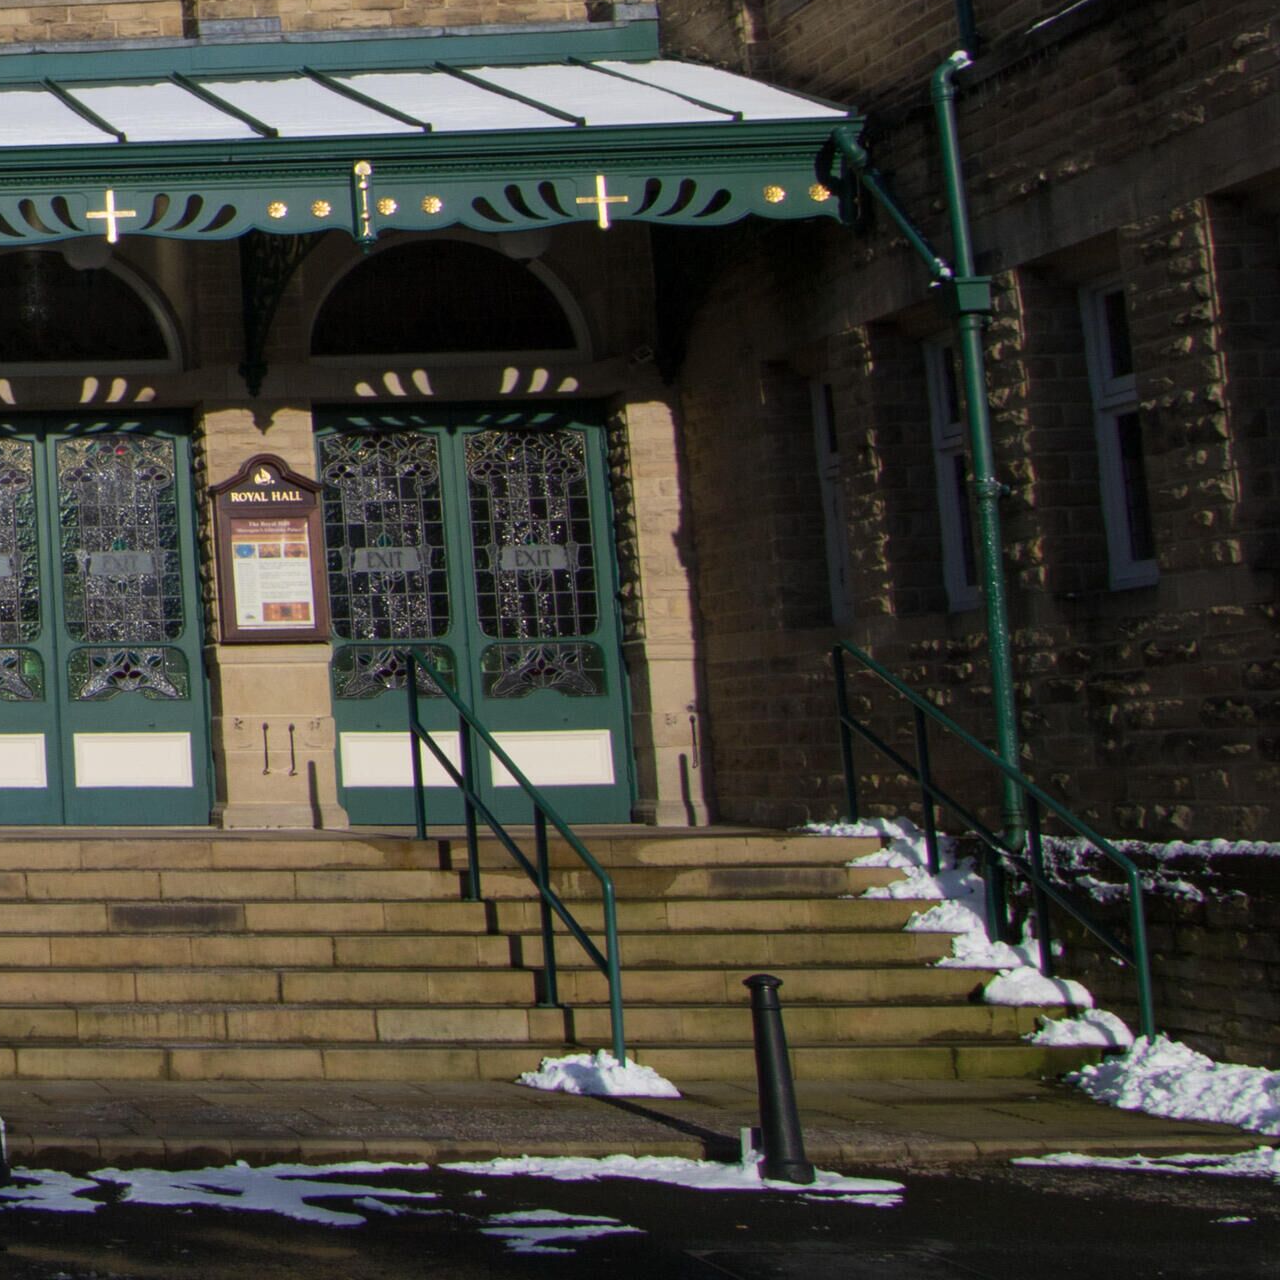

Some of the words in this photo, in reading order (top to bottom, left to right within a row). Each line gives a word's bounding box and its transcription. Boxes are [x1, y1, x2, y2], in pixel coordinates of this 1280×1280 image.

[231, 492, 268, 502] ROYAL
[272, 491, 303, 502] HALL
[367, 552, 403, 568] EXIT
[515, 550, 551, 567] EXIT
